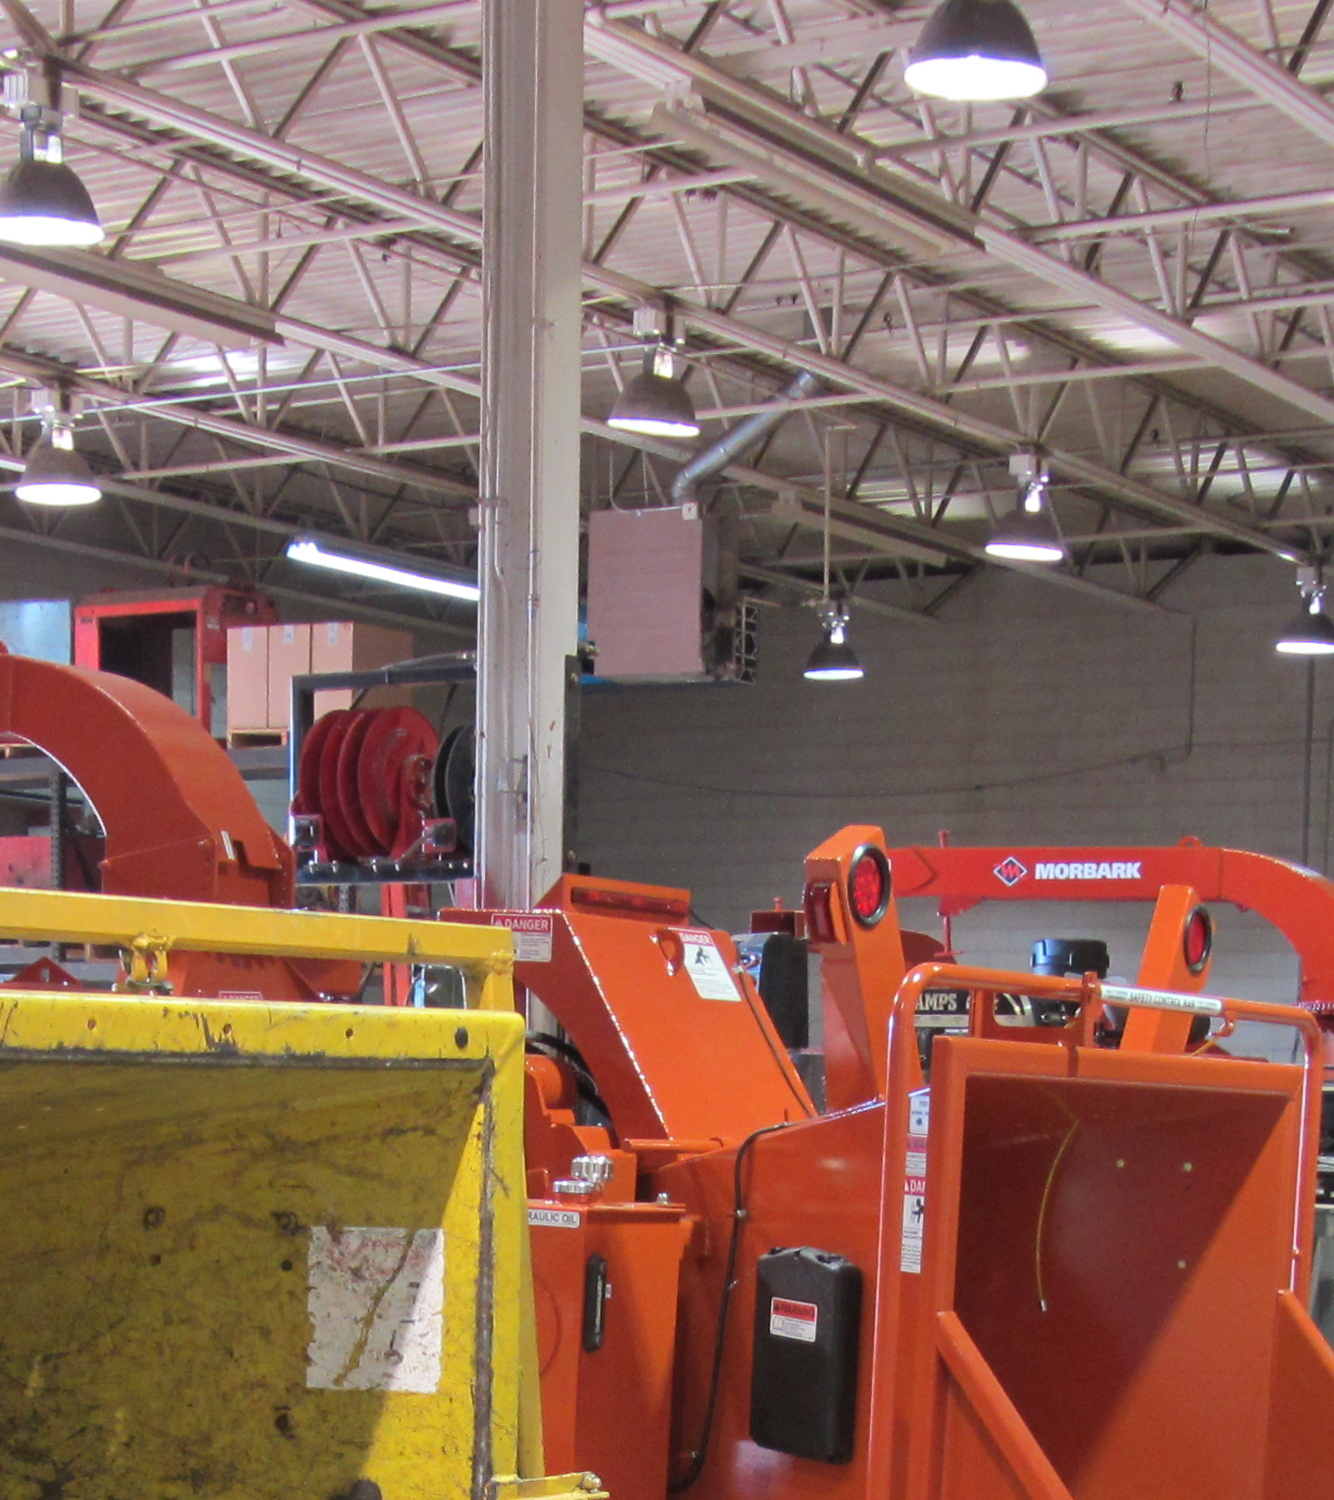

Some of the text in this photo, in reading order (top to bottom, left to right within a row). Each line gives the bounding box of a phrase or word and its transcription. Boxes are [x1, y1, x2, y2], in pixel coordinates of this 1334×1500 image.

[1035, 862, 1142, 880] MORBARK
[504, 917, 548, 931] DANGER
[679, 932, 714, 944] DANGER
[562, 1214, 577, 1223] OIL
